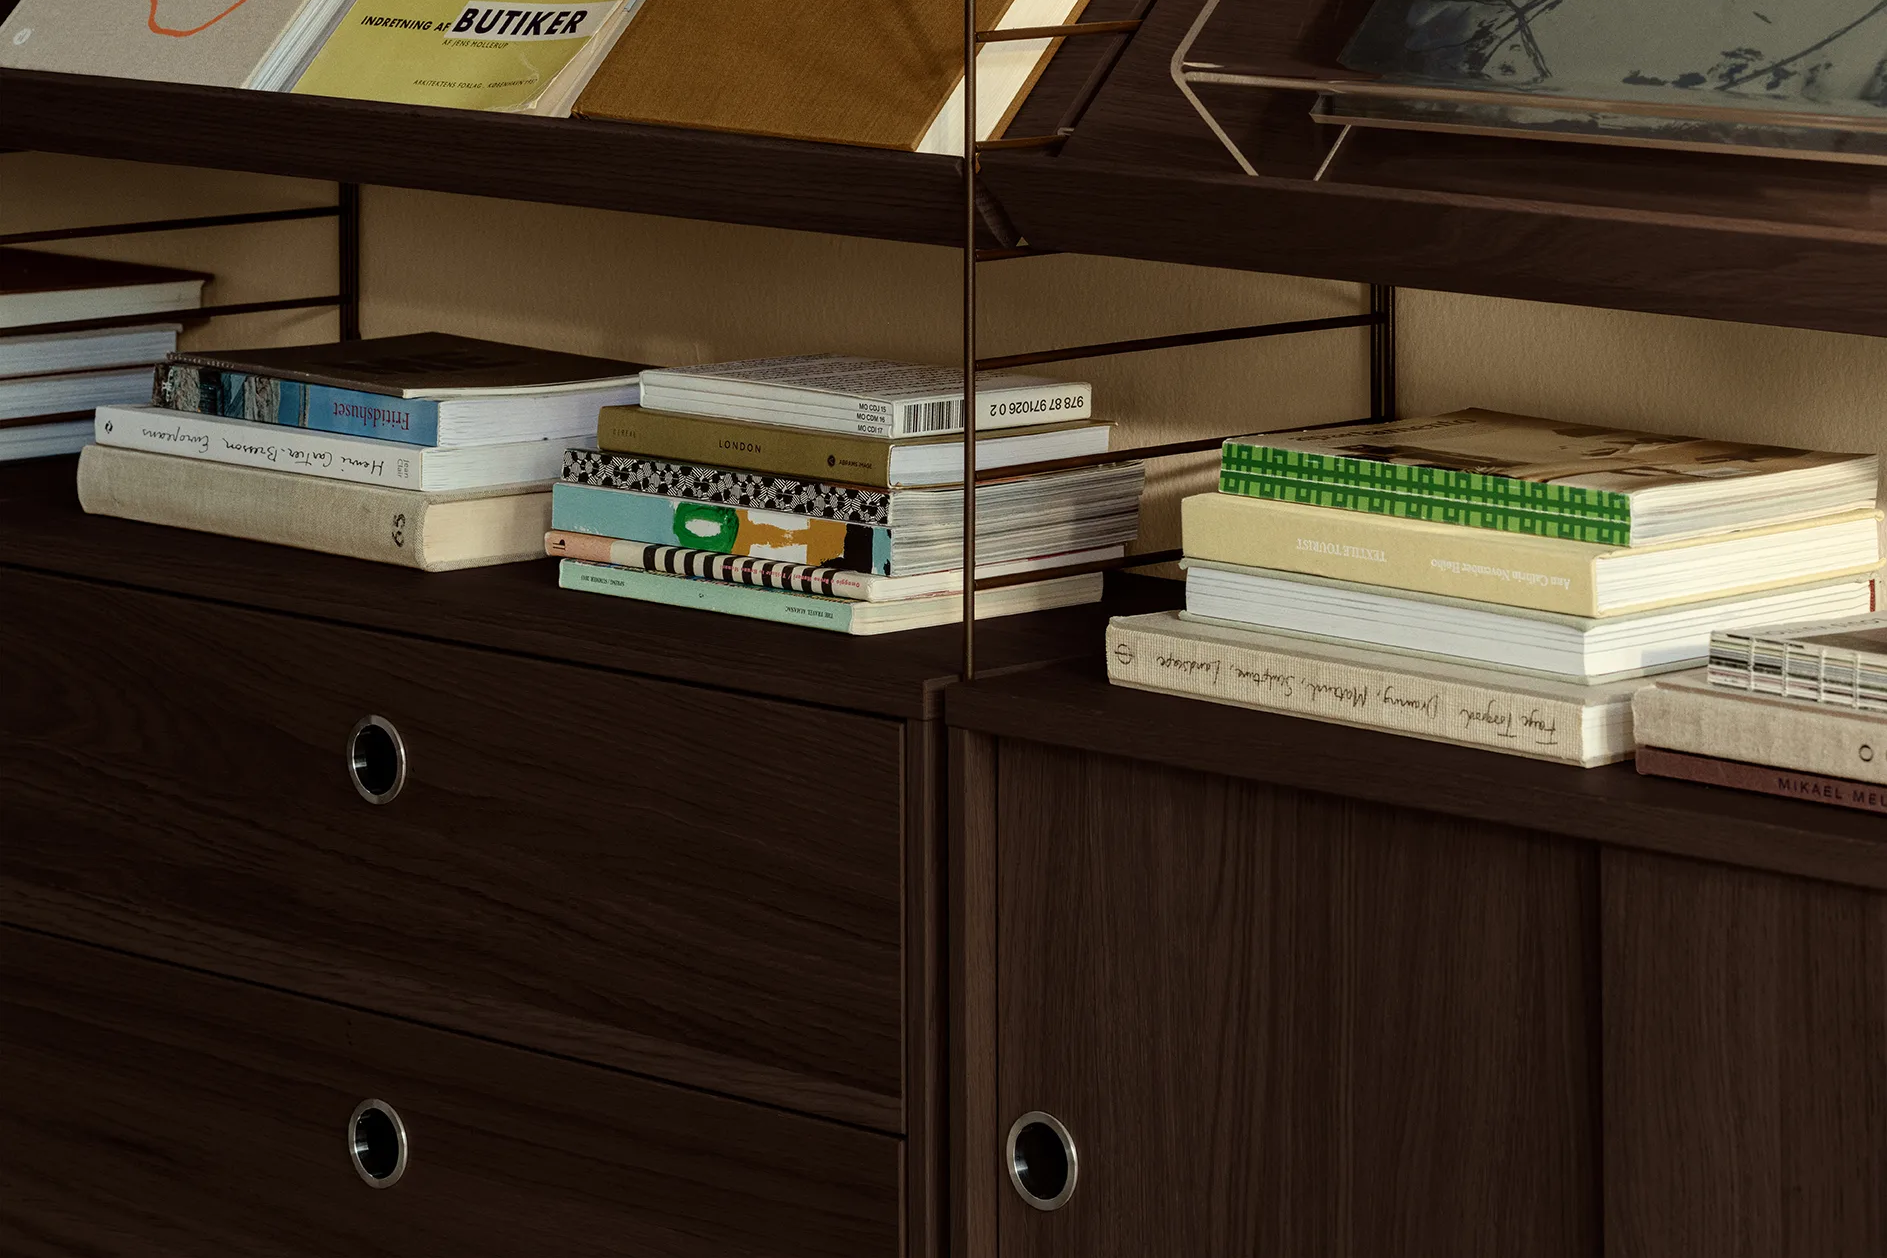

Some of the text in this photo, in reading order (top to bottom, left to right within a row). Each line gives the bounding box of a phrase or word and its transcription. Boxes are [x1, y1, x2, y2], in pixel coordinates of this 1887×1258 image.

[361, 7, 588, 36] INDRETNING AF BUTIKER
[451, 39, 471, 48] JENS
[413, 79, 456, 88] ARKITEKTENS
[859, 403, 868, 411] MO
[868, 404, 881, 412] CDJ
[989, 394, 1084, 416] 978 87 971026 0 2
[333, 401, 410, 432] Fritidshuset
[856, 413, 867, 421] MO
[867, 414, 879, 422] CDM
[857, 424, 883, 434] MO CDI 17
[140, 427, 385, 477] Henri Cartier-Bresson Europeans
[718, 439, 762, 454] LONDON
[396, 458, 404, 479] Clair
[838, 458, 873, 470] ABRAMS IMAGE
[1295, 538, 1388, 563] TEXTILE TOURIST
[1460, 562, 1511, 582] November
[1511, 569, 1549, 588] Cathrin
[835, 579, 861, 588] Omaggio
[1550, 575, 1571, 591] Ann
[784, 606, 834, 620] THE TRAVEL ALMANAC
[1155, 654, 1222, 685] Landscape
[1519, 708, 1558, 746] Faye
[1777, 777, 1843, 800] MIKAEL
